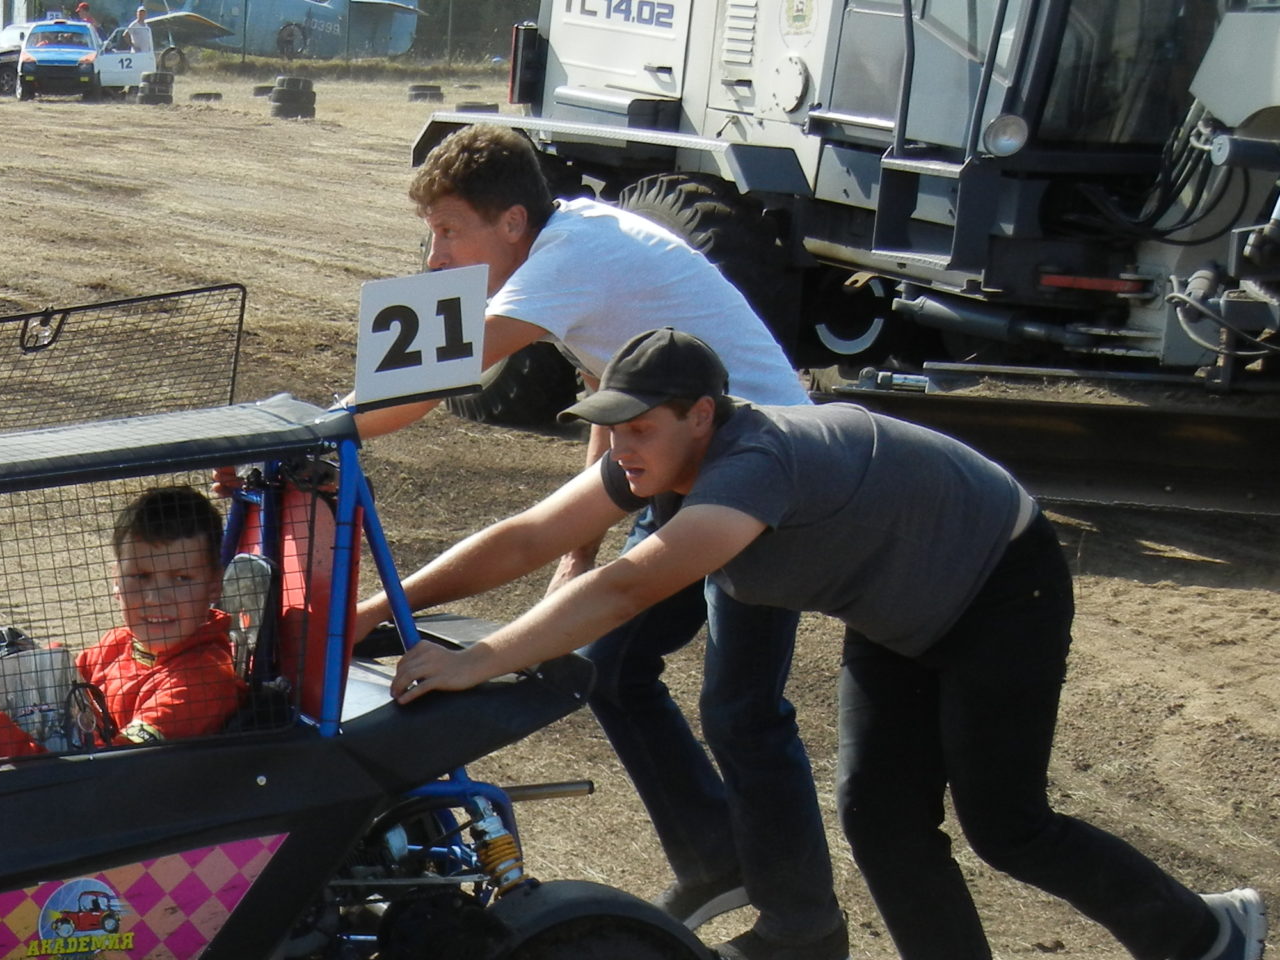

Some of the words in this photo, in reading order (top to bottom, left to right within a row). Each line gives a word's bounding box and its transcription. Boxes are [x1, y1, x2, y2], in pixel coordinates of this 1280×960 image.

[118, 58, 132, 69] 12
[371, 296, 474, 374] 21
[26, 932, 135, 956] АКАДЕМИЯ
